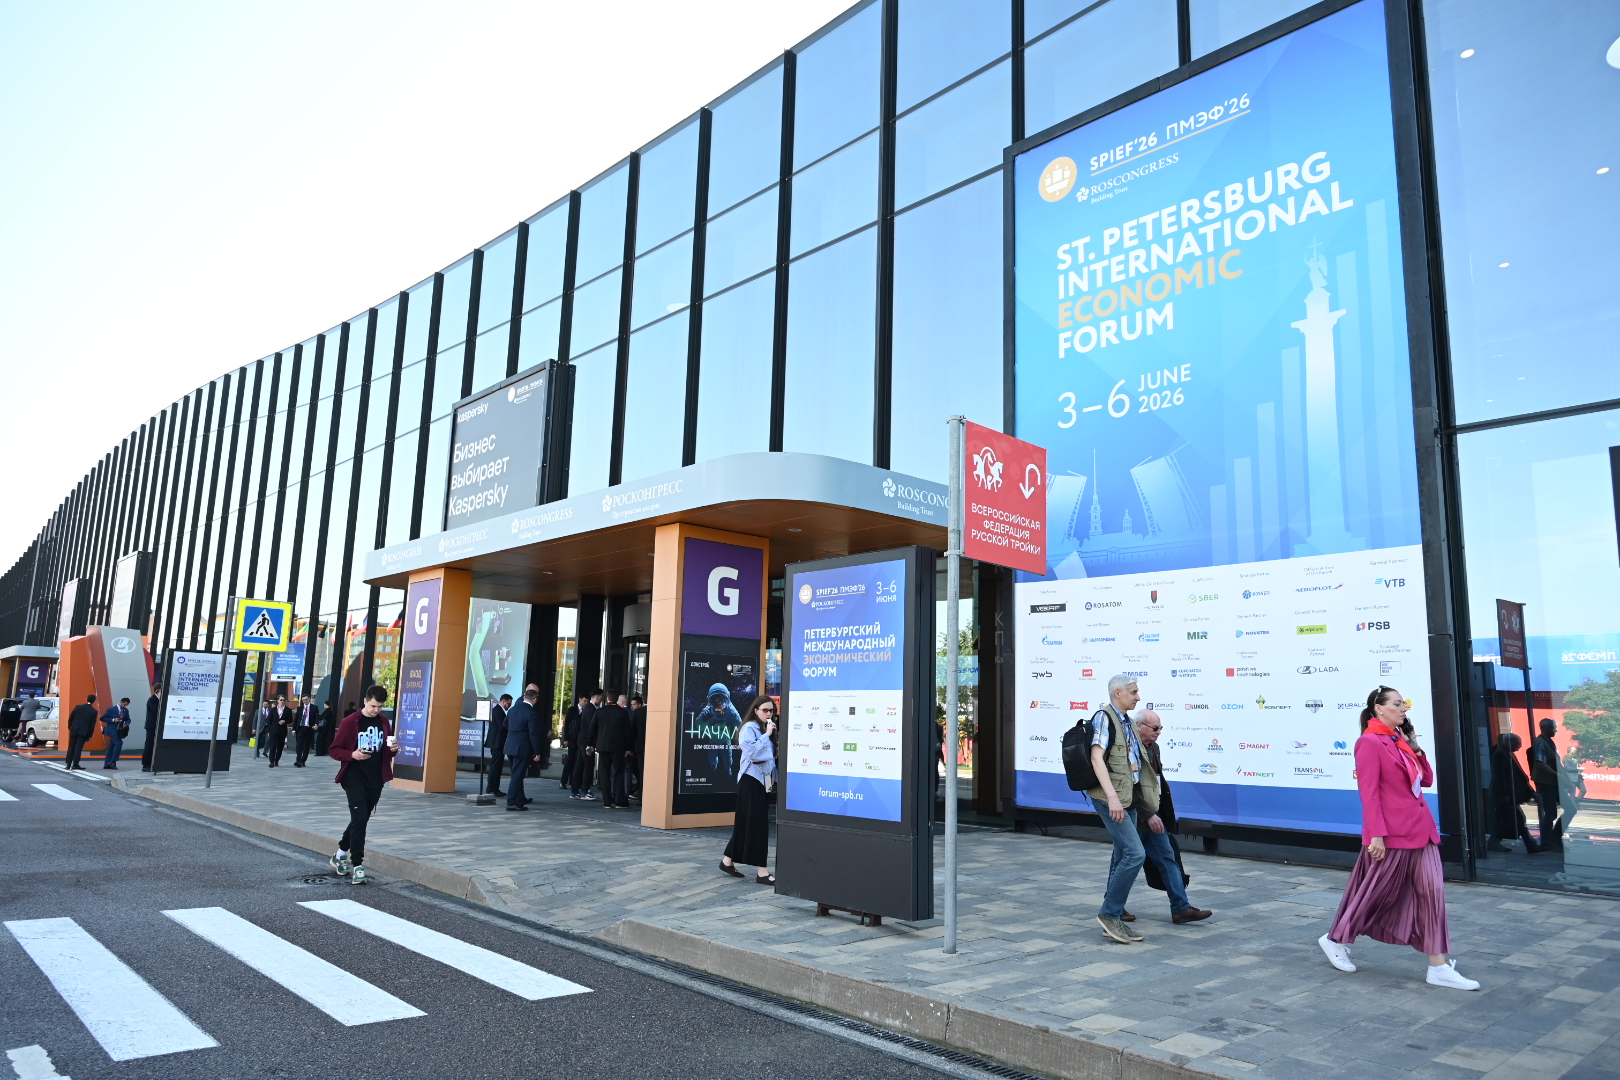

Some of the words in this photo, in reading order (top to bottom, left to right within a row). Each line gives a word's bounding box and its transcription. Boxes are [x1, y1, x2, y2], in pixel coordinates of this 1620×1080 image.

[1091, 152, 1180, 196] ROSCONGRESS
[1057, 237, 1096, 270] ST.
[1103, 151, 1331, 255] PETERSBURG
[1058, 181, 1354, 299] INTERNATIONAL
[1058, 249, 1243, 329] ECONOMIC
[1058, 302, 1174, 359] FORUM
[1138, 363, 1192, 393] JUNE
[457, 402, 489, 424] kaspersky
[1138, 388, 1185, 414] 2026
[453, 433, 497, 464] Бизнес
[451, 456, 510, 491] выбирает
[448, 482, 509, 518] Kaspersky
[612, 479, 684, 508] РОСКОНГРЕСС
[519, 507, 573, 530] ROSCONGRESS
[971, 502, 1041, 531] ВСЕРОССИЙСКАЯ
[971, 528, 1009, 548] РУССКОЙ
[1010, 538, 1041, 556] ТРОЙКИ
[983, 519, 1030, 541] ФЕДЕРАЦИЯ
[707, 566, 740, 616] G
[1384, 578, 1405, 588] VTB
[876, 594, 897, 603] ИЮНЯ
[1093, 601, 1122, 609] ROSATOM
[1198, 593, 1219, 602] SBER
[414, 597, 430, 635] G
[1367, 621, 1391, 631] PSB
[803, 634, 896, 653] МЕЖДУНАРОДНЫЙ
[804, 621, 881, 640] ПЕТЕРБУРГСКИЙ
[1187, 631, 1208, 640] MIR
[803, 648, 892, 665] ЭКОНОМИЧЕСКИЙ
[26, 665, 40, 679] G
[802, 666, 837, 678] ФОРУМ
[685, 712, 739, 739] НАЧАЛ
[818, 787, 864, 801] forum-spb.ru
